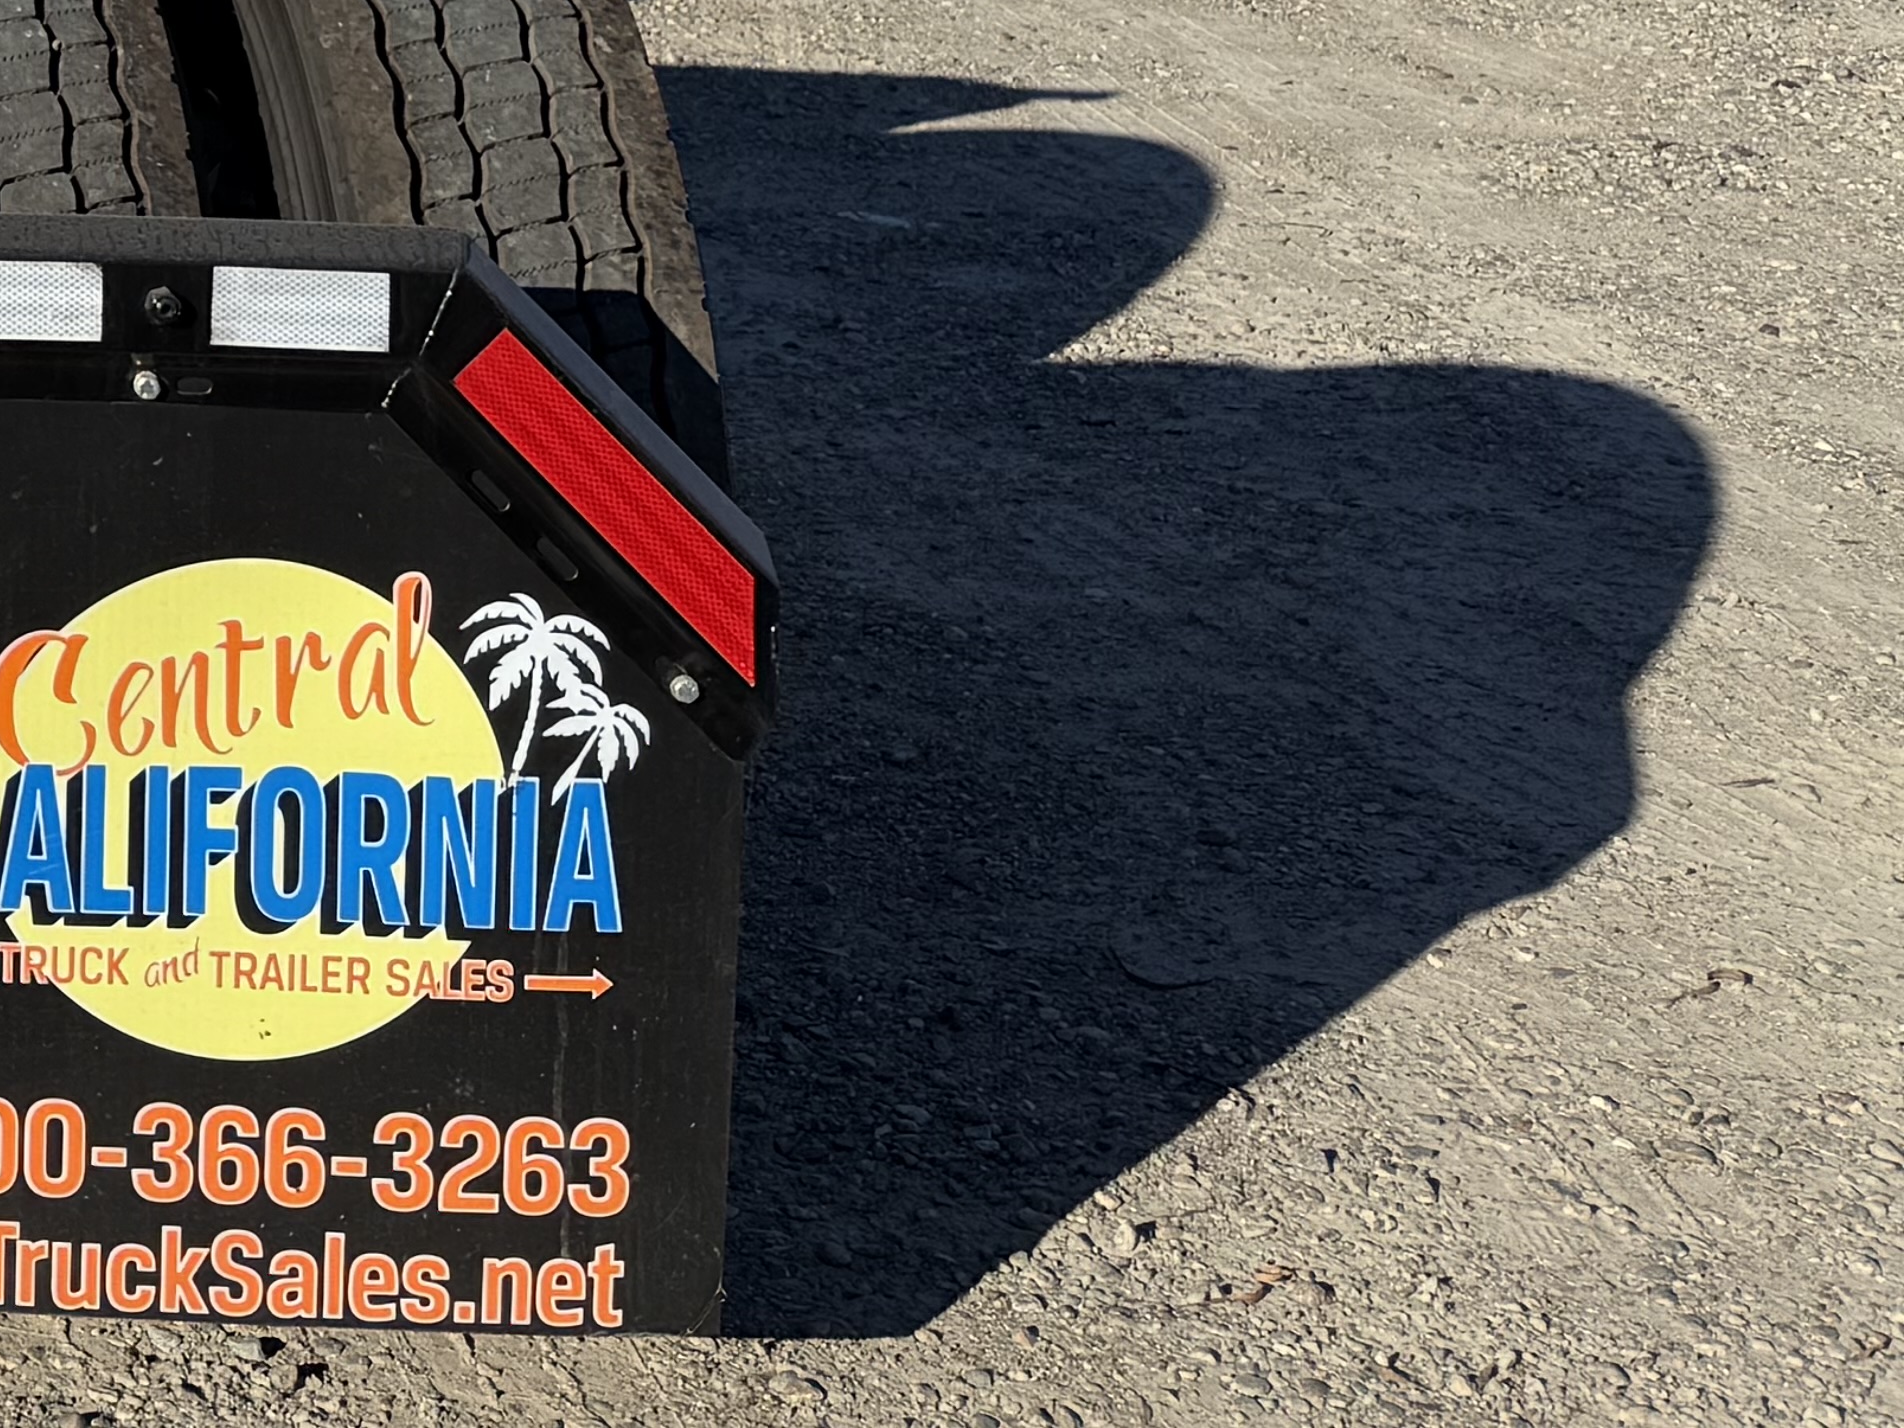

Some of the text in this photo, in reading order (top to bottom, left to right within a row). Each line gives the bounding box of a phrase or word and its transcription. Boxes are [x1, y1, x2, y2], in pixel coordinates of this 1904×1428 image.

[143, 936, 200, 990] and
[209, 950, 371, 997] TRAILER
[385, 956, 514, 1003] SALES
